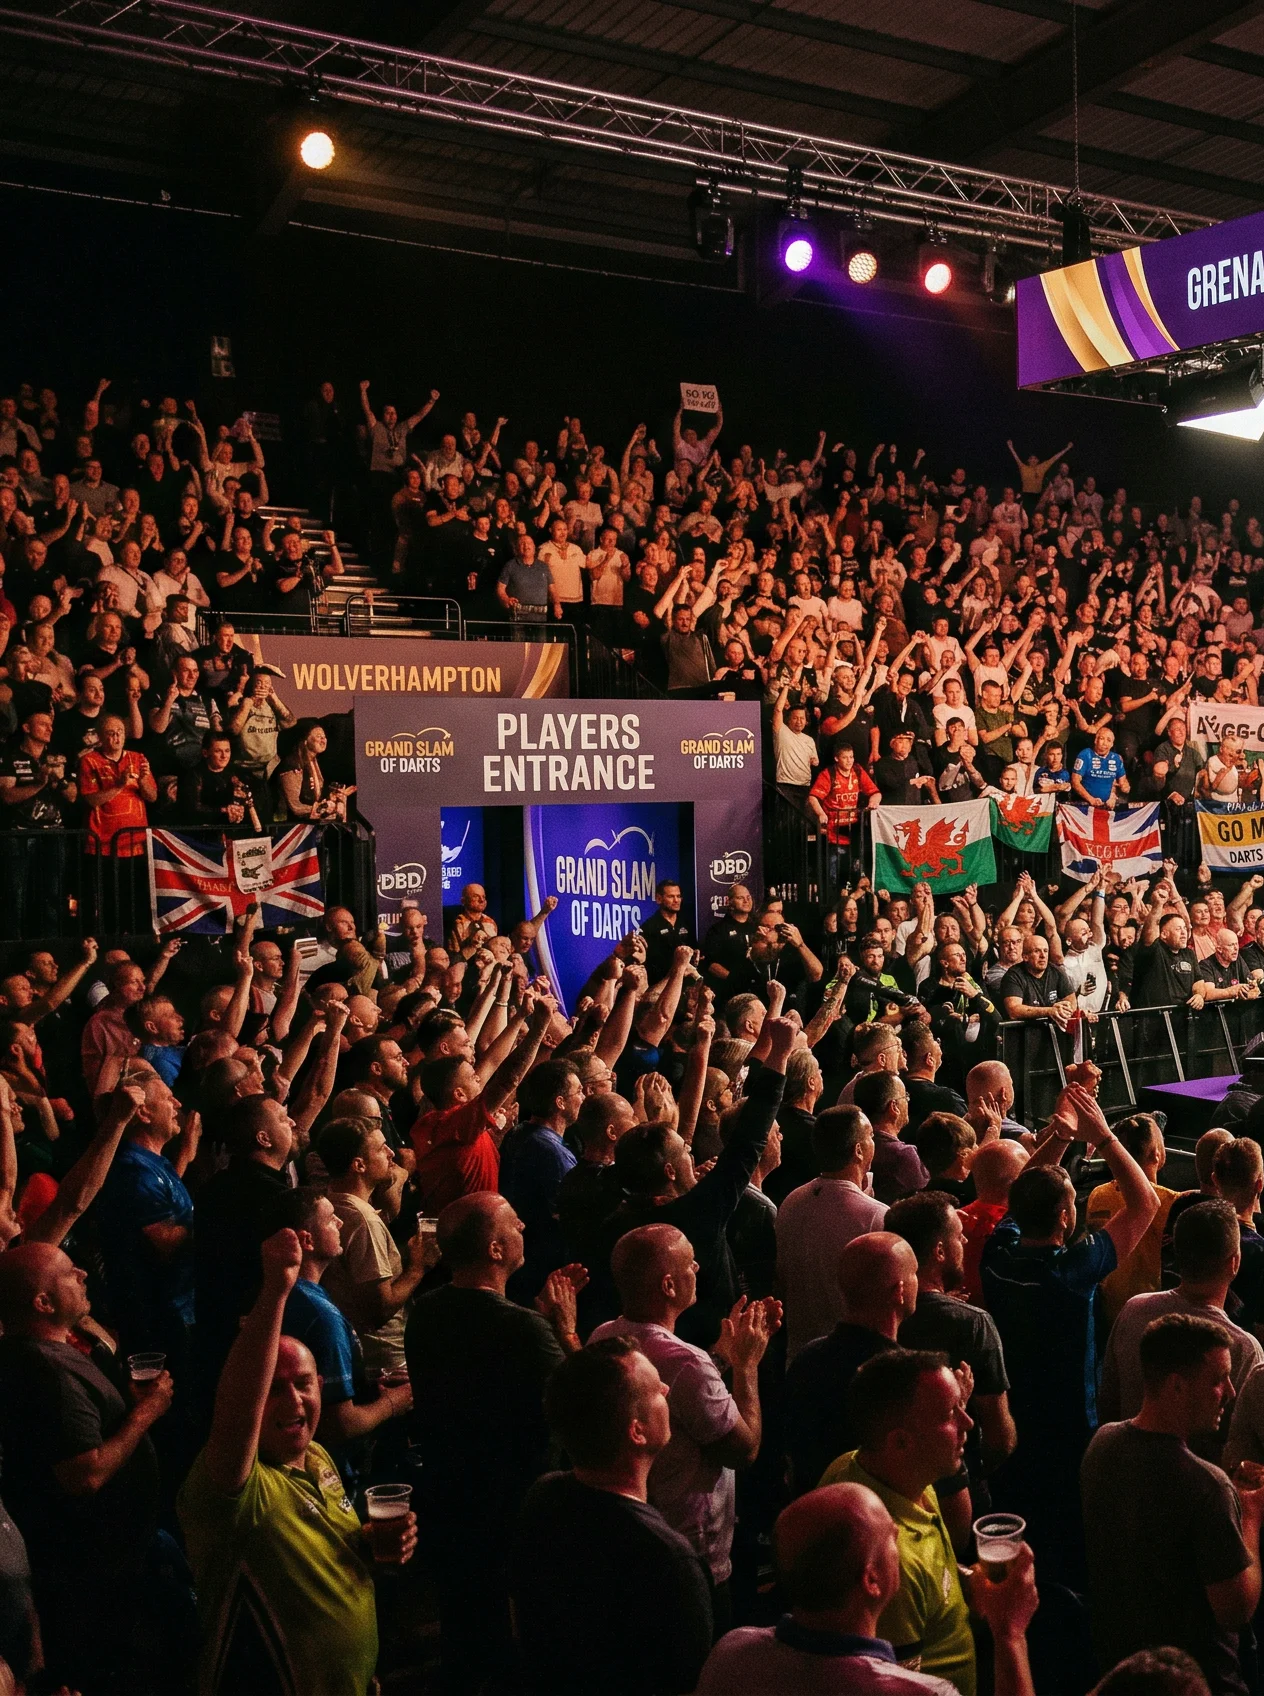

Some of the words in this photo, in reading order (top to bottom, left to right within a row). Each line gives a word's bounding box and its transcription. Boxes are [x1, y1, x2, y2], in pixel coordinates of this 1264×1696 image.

[292, 663, 501, 693] WOLVERHAMPTON
[497, 713, 640, 750] PLAYERS
[365, 740, 413, 757] GRAND
[416, 740, 454, 757] SLAM
[680, 739, 721, 755] GRAND
[722, 739, 755, 755] SLAM
[380, 757, 397, 773] OF
[399, 757, 441, 773] DARTS
[693, 754, 708, 770] OF
[709, 754, 745, 769] DARTS
[483, 754, 656, 792] ENTRANCE
[1217, 819, 1244, 843] GO
[1229, 848, 1264, 864] DARTS
[713, 858, 747, 876] DBD
[381, 872, 421, 890] DBD
[556, 855, 608, 897] GRAND
[611, 859, 656, 902] SLAM
[571, 899, 589, 937] OF
[592, 901, 643, 941] DARTS
